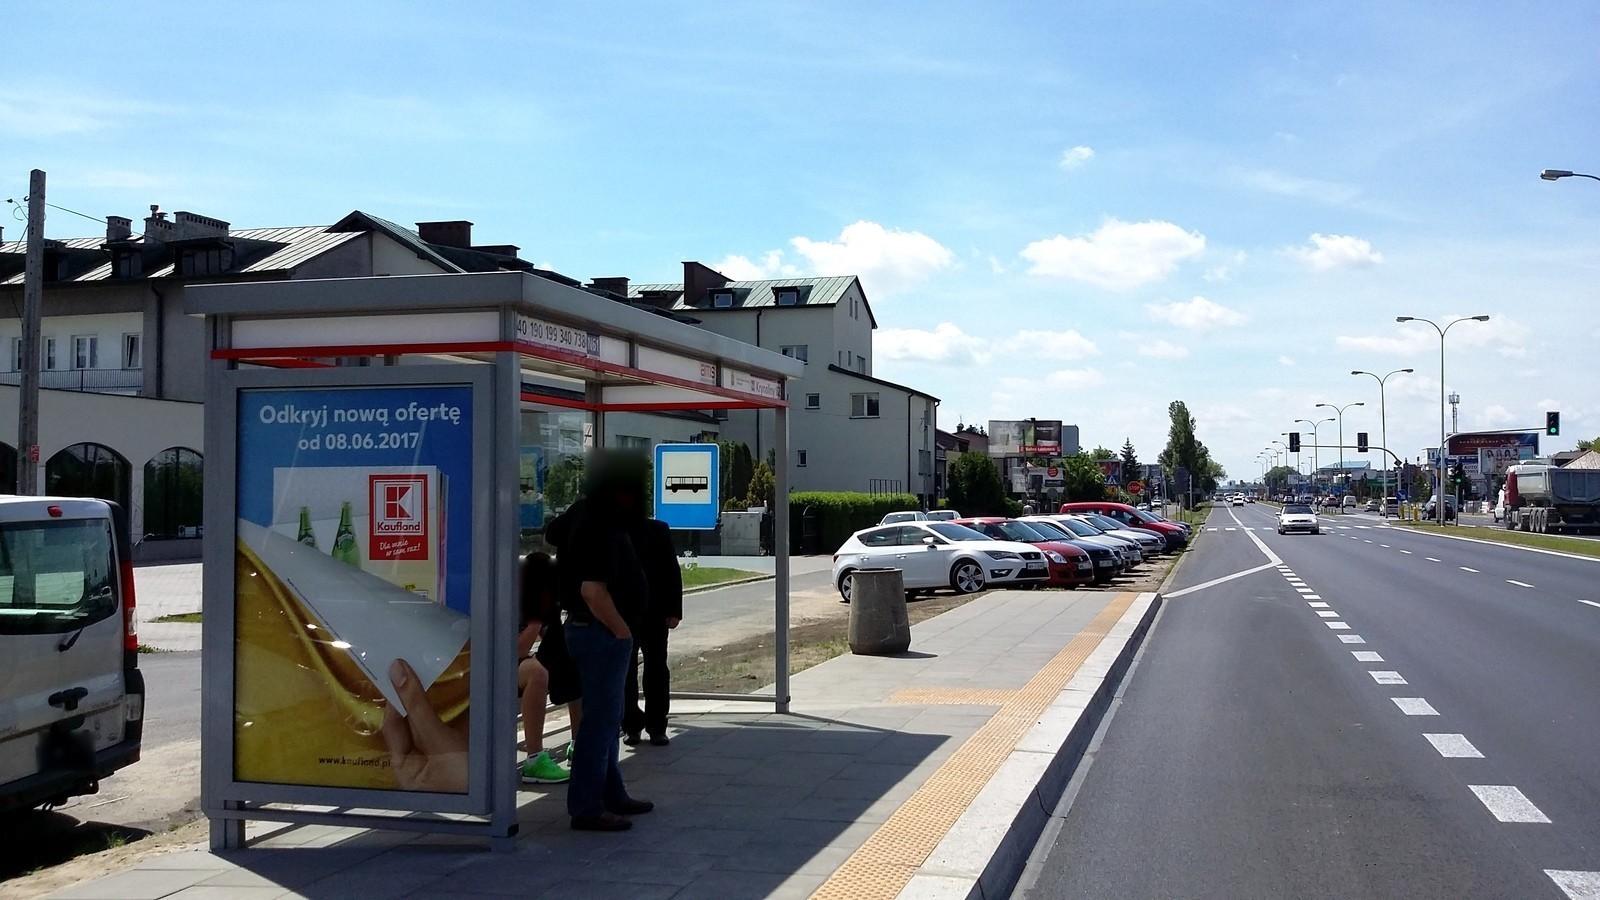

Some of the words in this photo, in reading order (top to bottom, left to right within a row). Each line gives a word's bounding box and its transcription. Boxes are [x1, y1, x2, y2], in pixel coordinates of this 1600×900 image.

[530, 322, 543, 339] 190
[545, 325, 558, 342] 199
[560, 328, 572, 345] 340
[574, 331, 586, 349] 738
[700, 363, 716, 379] ams
[259, 405, 328, 428] Odkryj
[334, 407, 389, 427] nową
[395, 402, 462, 425] ofertę
[299, 434, 321, 451] od
[325, 432, 419, 451] 08.06.2017
[377, 521, 421, 531] Kaufland
